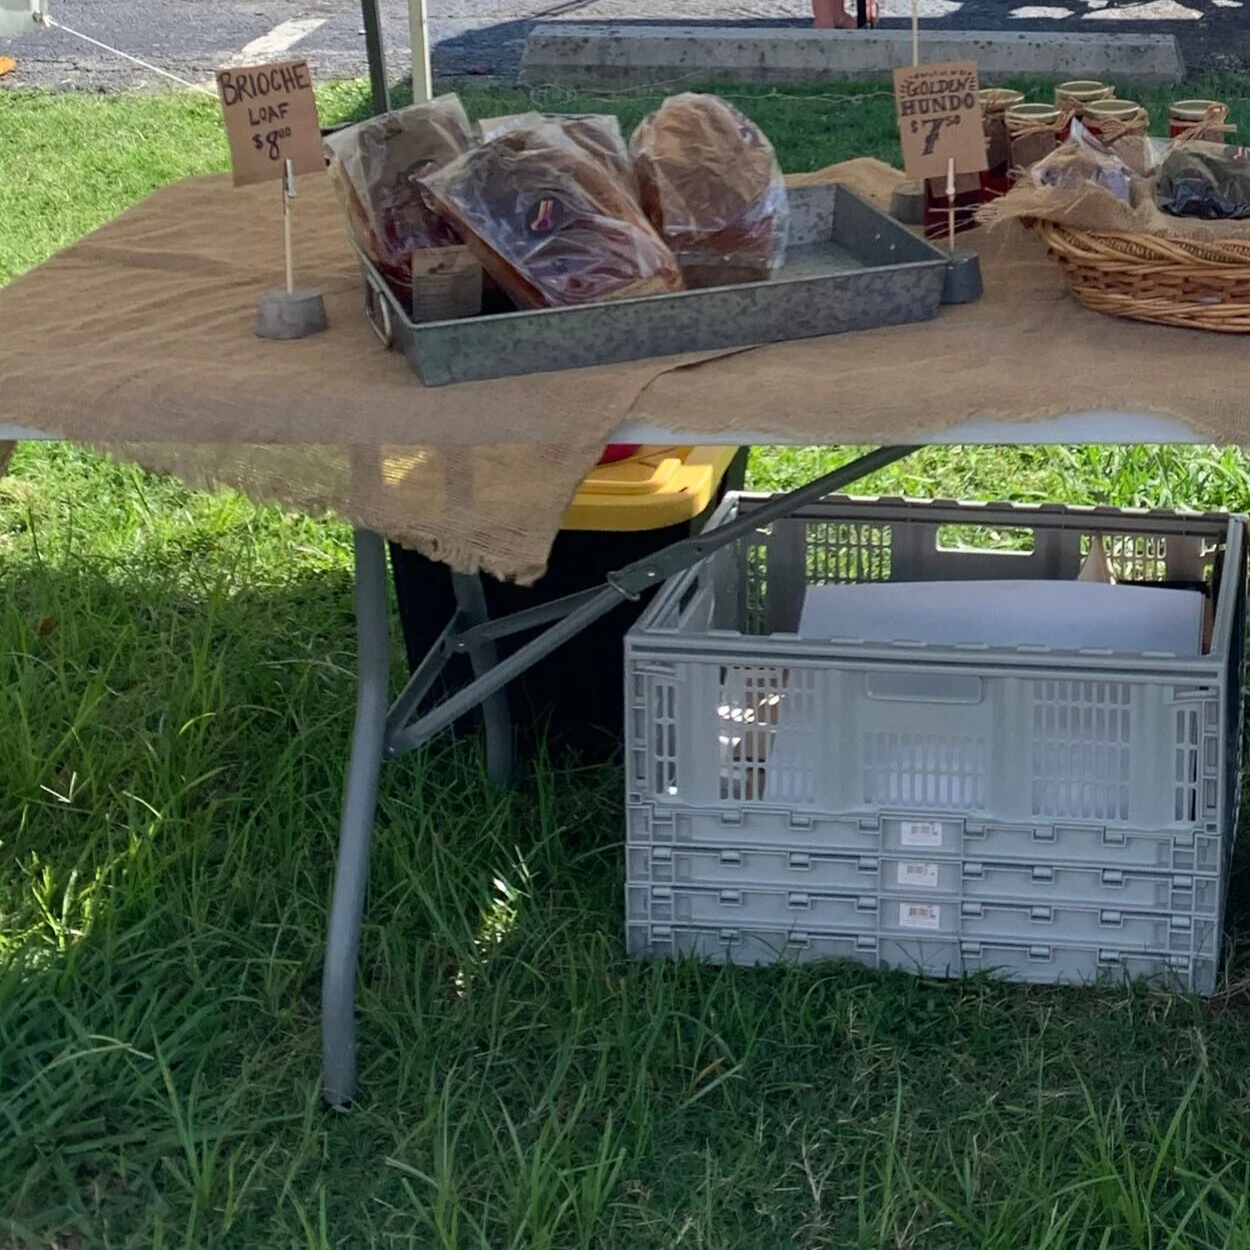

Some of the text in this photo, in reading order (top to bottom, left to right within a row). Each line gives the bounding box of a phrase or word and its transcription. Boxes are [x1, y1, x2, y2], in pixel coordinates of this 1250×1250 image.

[217, 62, 310, 106] BRIOCHE
[907, 77, 969, 97] GOLDEN
[248, 102, 289, 126] LOAF
[901, 93, 974, 117] HUNDO
